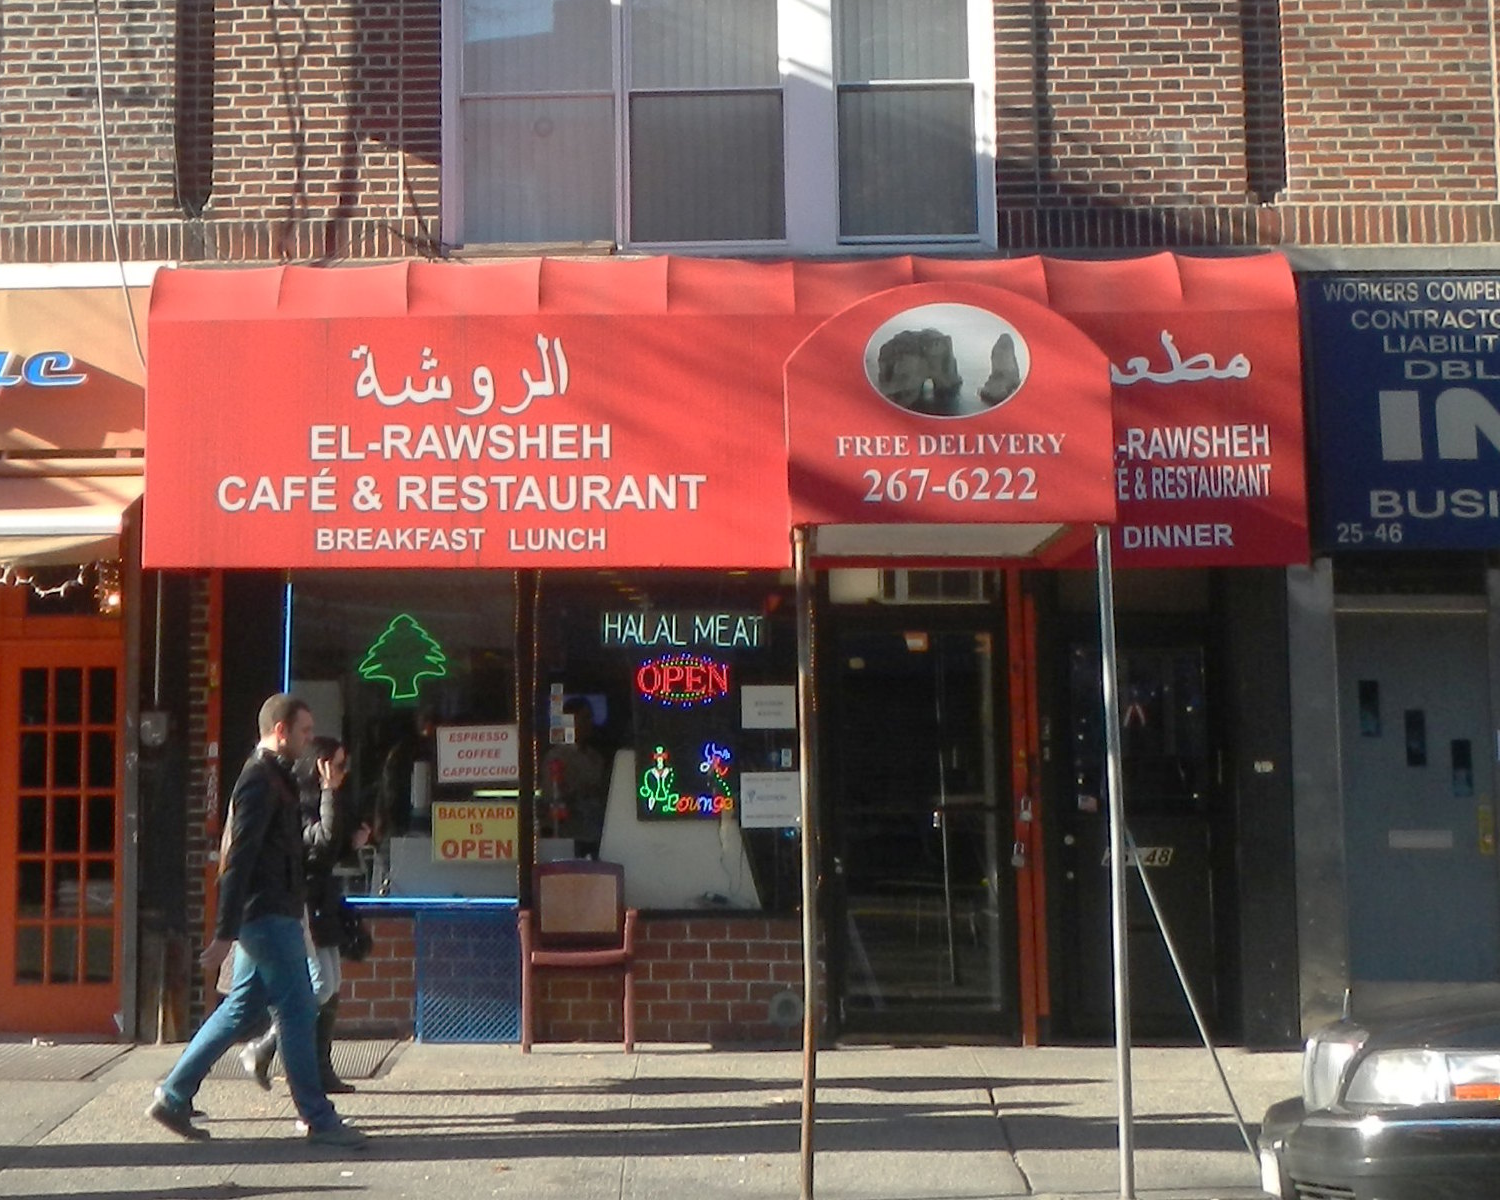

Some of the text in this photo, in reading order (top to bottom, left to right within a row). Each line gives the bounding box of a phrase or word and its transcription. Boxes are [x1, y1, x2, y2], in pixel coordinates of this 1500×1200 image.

[1323, 282, 1418, 301] WORKERS
[1111, 329, 1252, 385] مطع
[350, 332, 570, 416] الروشة
[309, 425, 612, 461] EL-RAWSHEH
[836, 433, 1067, 457] FREE DELIVERY
[218, 469, 707, 512] CAFÉ & RESTAURANT
[862, 466, 1039, 503] 267-6222
[1135, 467, 1147, 499] &
[1152, 464, 1271, 499] RESTAURANT
[316, 528, 607, 552] BREAKFAST LUNCH
[1123, 524, 1235, 549] DINNER
[1337, 523, 1403, 544] 25-46
[604, 613, 763, 647] HALAL MEAT
[636, 664, 729, 694] OPEN
[449, 731, 508, 743] ESPRESSO
[457, 748, 502, 760] COFFEE
[442, 765, 518, 777] CAPPUCCINO
[438, 807, 515, 820] BACKYARD
[662, 793, 734, 813] Lounge
[469, 822, 483, 835] IS
[441, 839, 514, 860] OPEN
